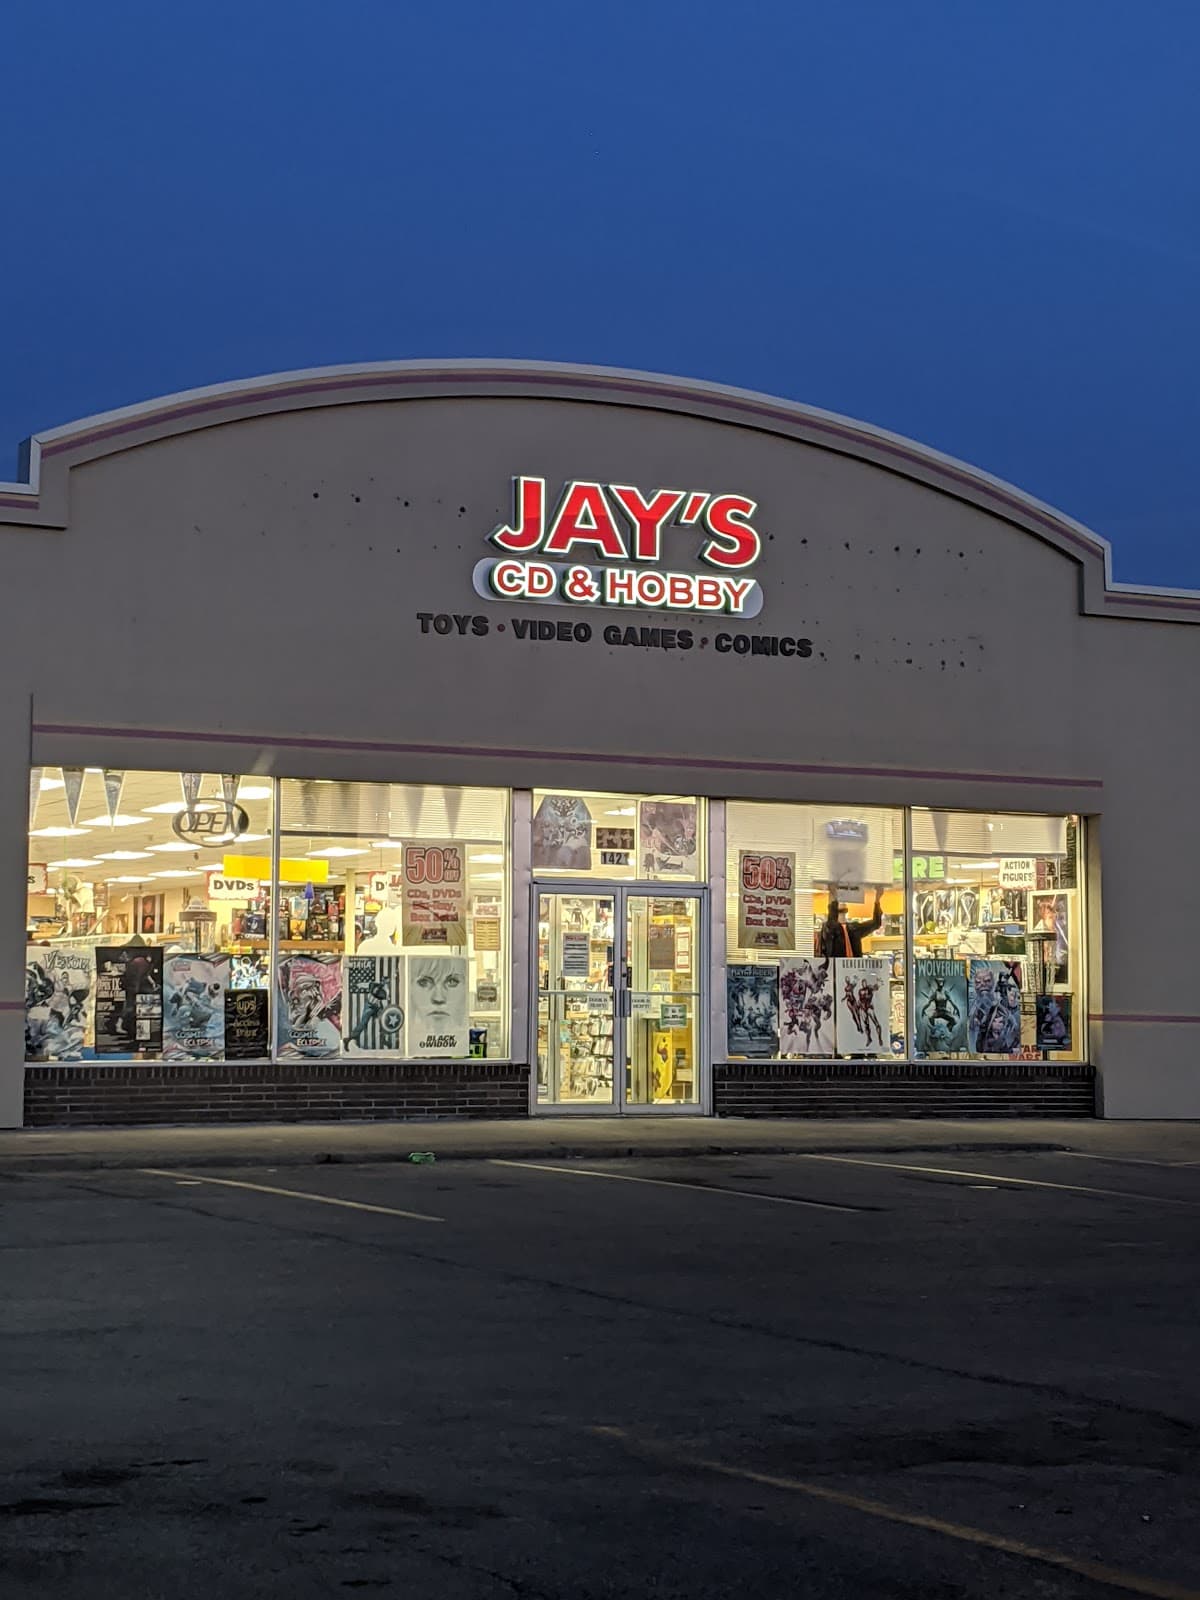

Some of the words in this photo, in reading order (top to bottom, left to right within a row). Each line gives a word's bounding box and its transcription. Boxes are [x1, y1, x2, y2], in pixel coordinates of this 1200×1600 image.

[492, 475, 762, 570] JAY'S
[492, 561, 556, 597] CD
[565, 566, 601, 602] &
[606, 569, 756, 613] HOBBY
[417, 612, 489, 636] TOYS
[511, 618, 592, 643] VIDEO
[603, 625, 694, 650] GAMES
[715, 633, 813, 658] COMICS
[179, 811, 240, 836] OPEN
[406, 847, 461, 884] 50%
[743, 855, 792, 891] 50%
[893, 856, 945, 879] ERE
[1002, 873, 1033, 882] FIGURES
[1004, 861, 1031, 870] ACTION
[213, 880, 255, 891] DVDs
[917, 960, 965, 977] WOLVERINE
[425, 1041, 457, 1049] WIDOW
